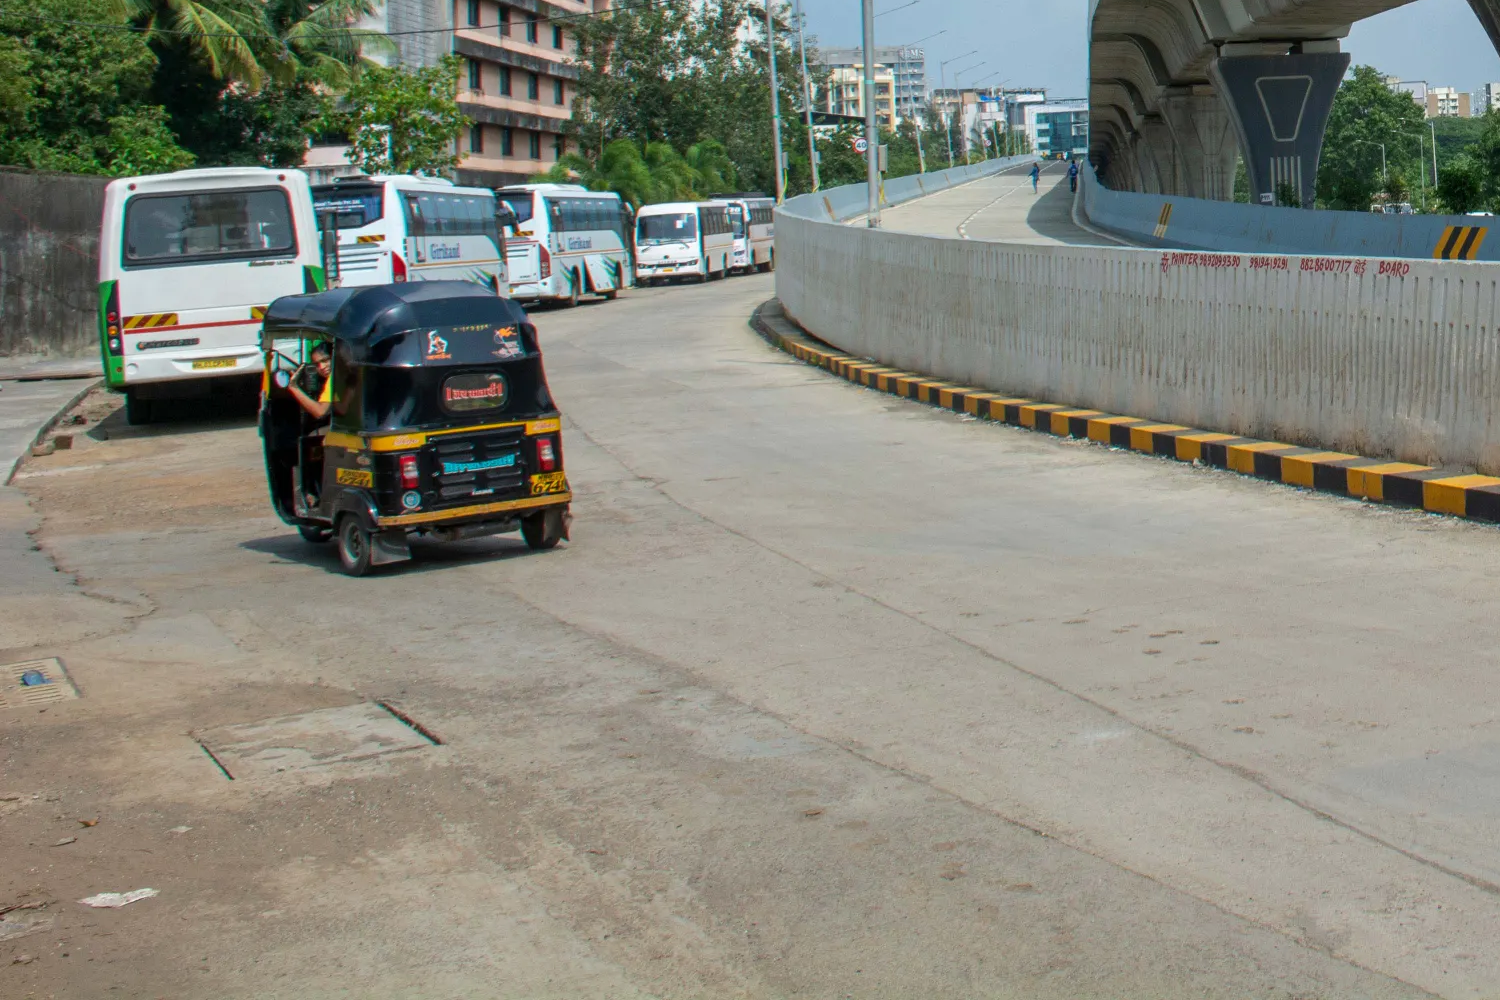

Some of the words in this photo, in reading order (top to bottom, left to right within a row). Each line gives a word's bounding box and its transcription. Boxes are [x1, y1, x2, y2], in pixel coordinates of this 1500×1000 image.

[856, 141, 867, 149] 40
[1171, 252, 1198, 266] PAINTER
[1300, 258, 1352, 273] 8828600717
[1379, 261, 1411, 277] BOARD
